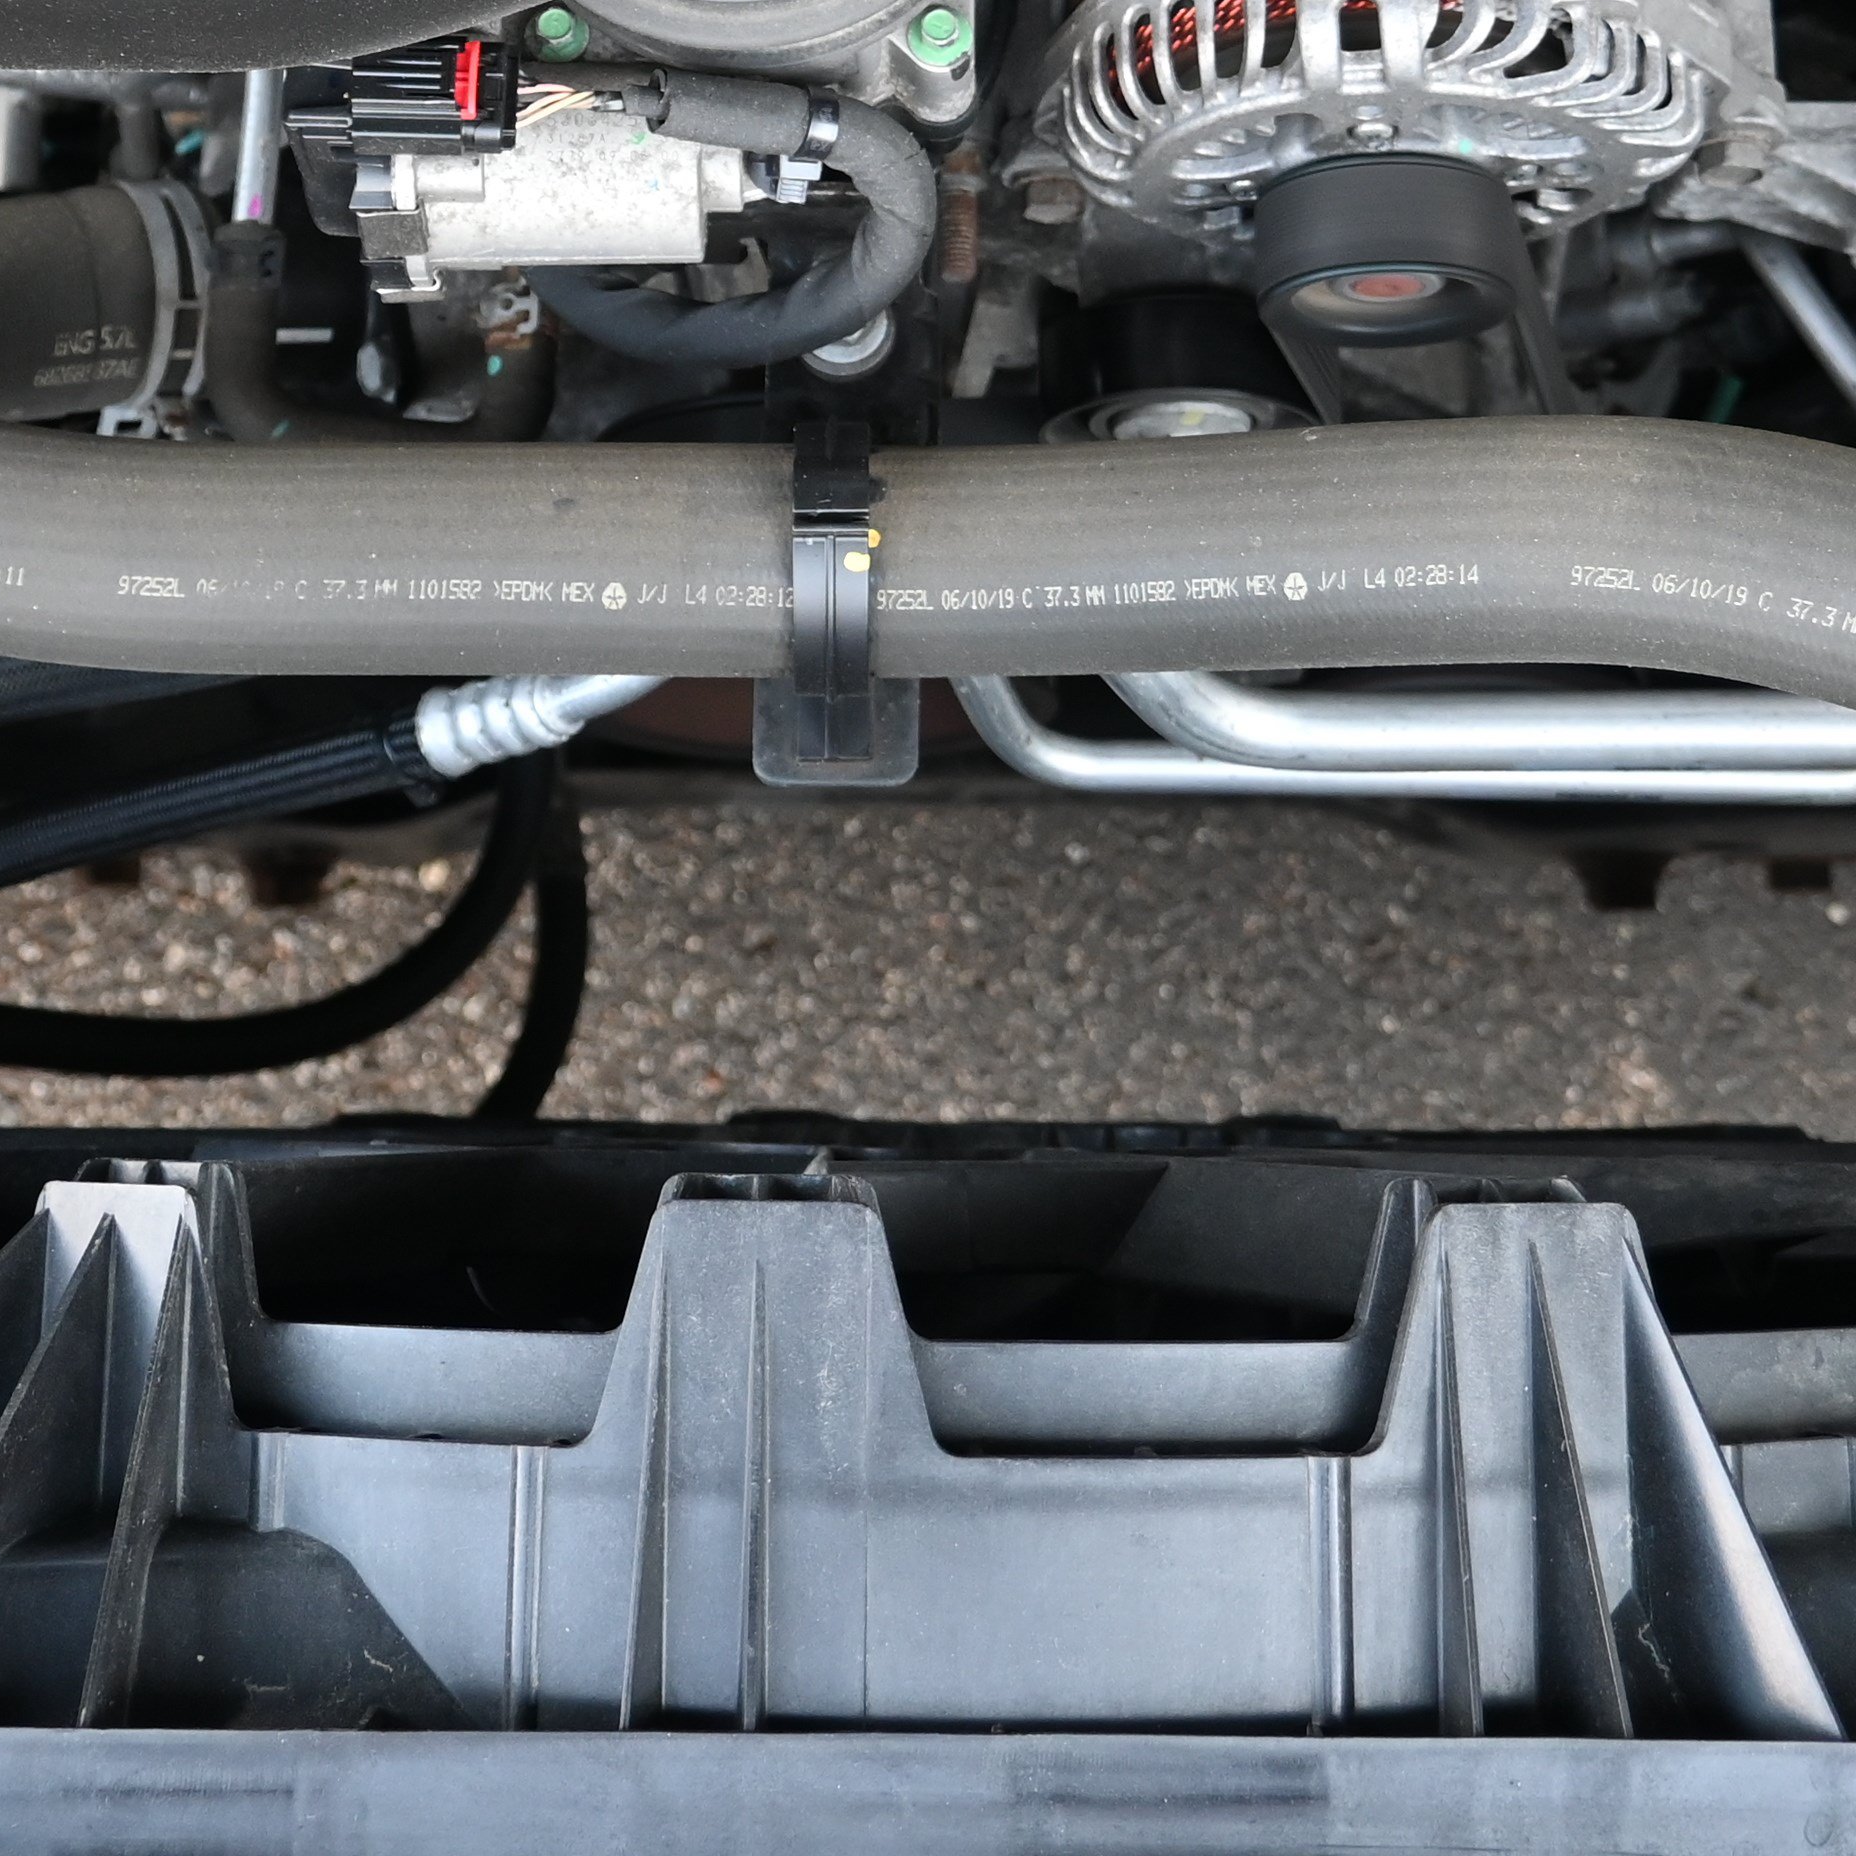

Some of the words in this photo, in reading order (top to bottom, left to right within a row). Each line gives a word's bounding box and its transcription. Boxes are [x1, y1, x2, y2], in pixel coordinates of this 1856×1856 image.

[117, 575, 185, 598] 97252L
[374, 578, 397, 595] MM
[408, 579, 481, 600] 1101582
[562, 581, 594, 602] MEX
[637, 584, 667, 604] J/J
[685, 585, 706, 605] L4
[877, 589, 932, 611] 97252L
[941, 586, 1015, 610] 06/10/19
[1023, 586, 1033, 608] C
[1044, 584, 1080, 607] 37.3
[1086, 582, 1105, 605] MM
[1113, 580, 1176, 604] 1101582
[1247, 574, 1276, 596] MEX
[1317, 569, 1346, 591] J/J
[1363, 566, 1385, 589] L4
[1393, 563, 1479, 586] 02:28:14
[1571, 564, 1639, 592] 97252L
[1652, 571, 1748, 606] 06/10/19
[1759, 591, 1773, 612] C
[1787, 596, 1836, 628] 37.3
